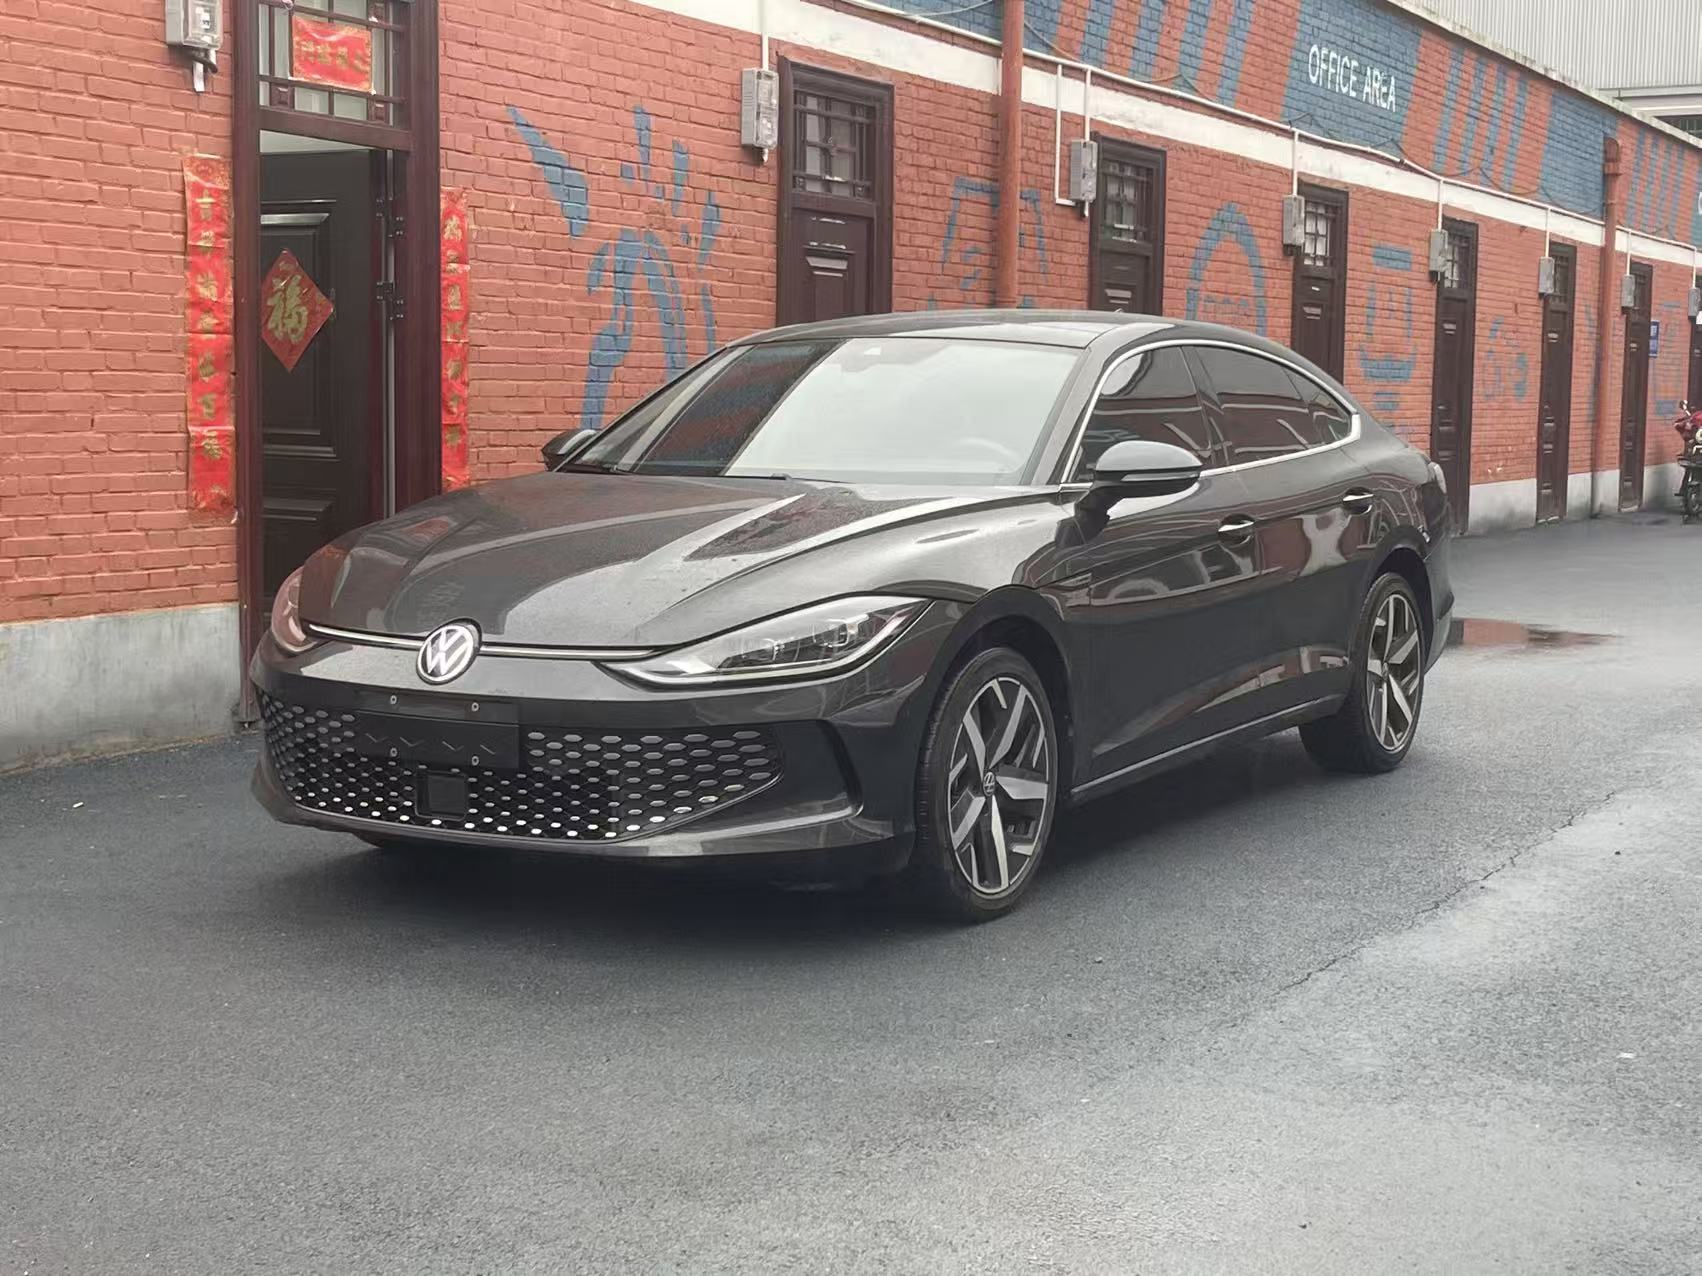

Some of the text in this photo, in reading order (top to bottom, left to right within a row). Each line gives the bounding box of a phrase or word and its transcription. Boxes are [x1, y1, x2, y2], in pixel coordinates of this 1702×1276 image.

[1308, 44, 1396, 112] OFFICE AREA
[267, 275, 308, 345] 福
